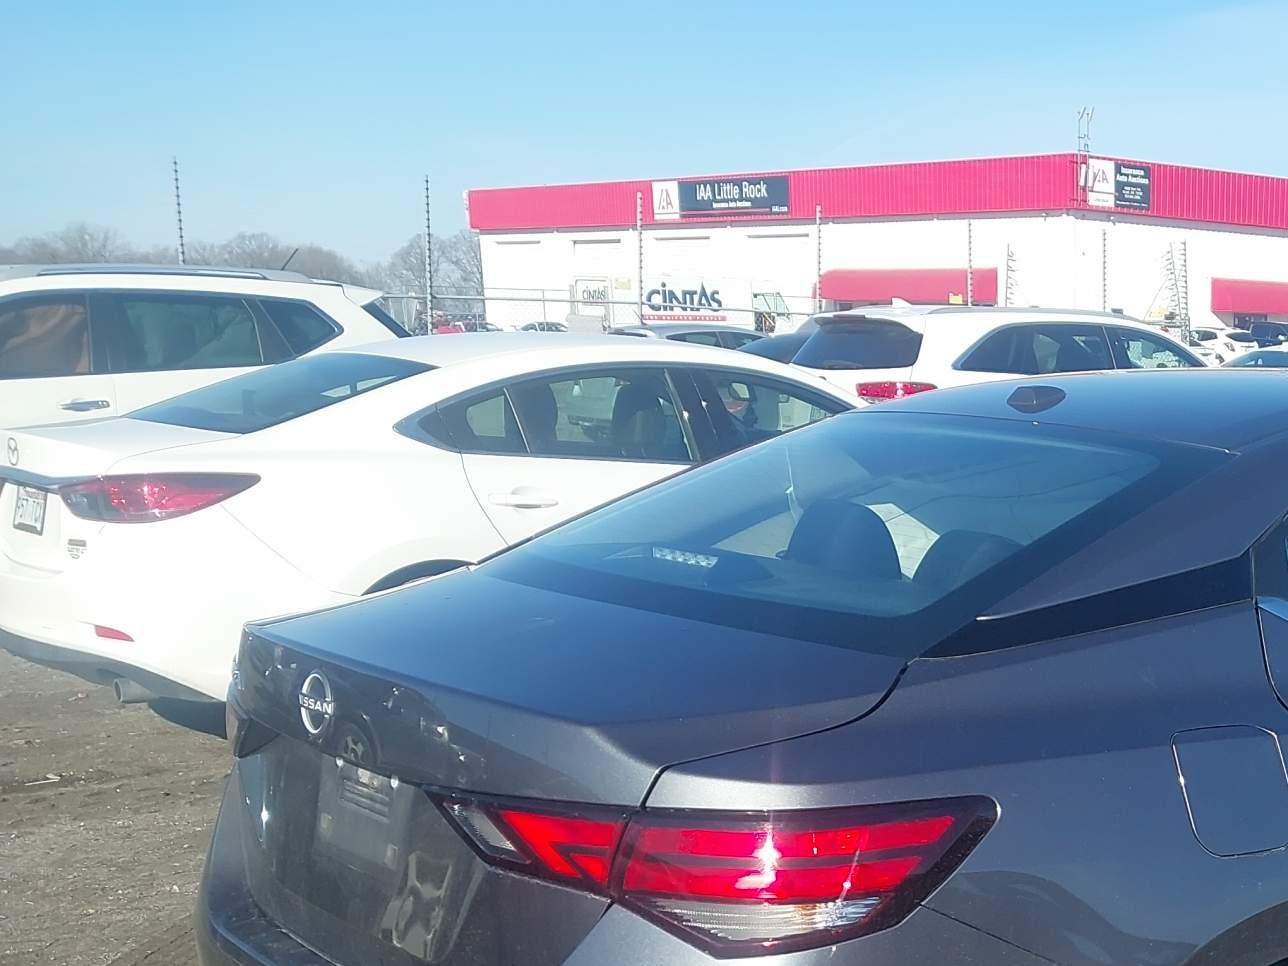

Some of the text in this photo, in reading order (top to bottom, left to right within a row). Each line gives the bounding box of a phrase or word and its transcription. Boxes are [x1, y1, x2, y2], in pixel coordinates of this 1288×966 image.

[696, 180, 767, 200] IAA Little Rock
